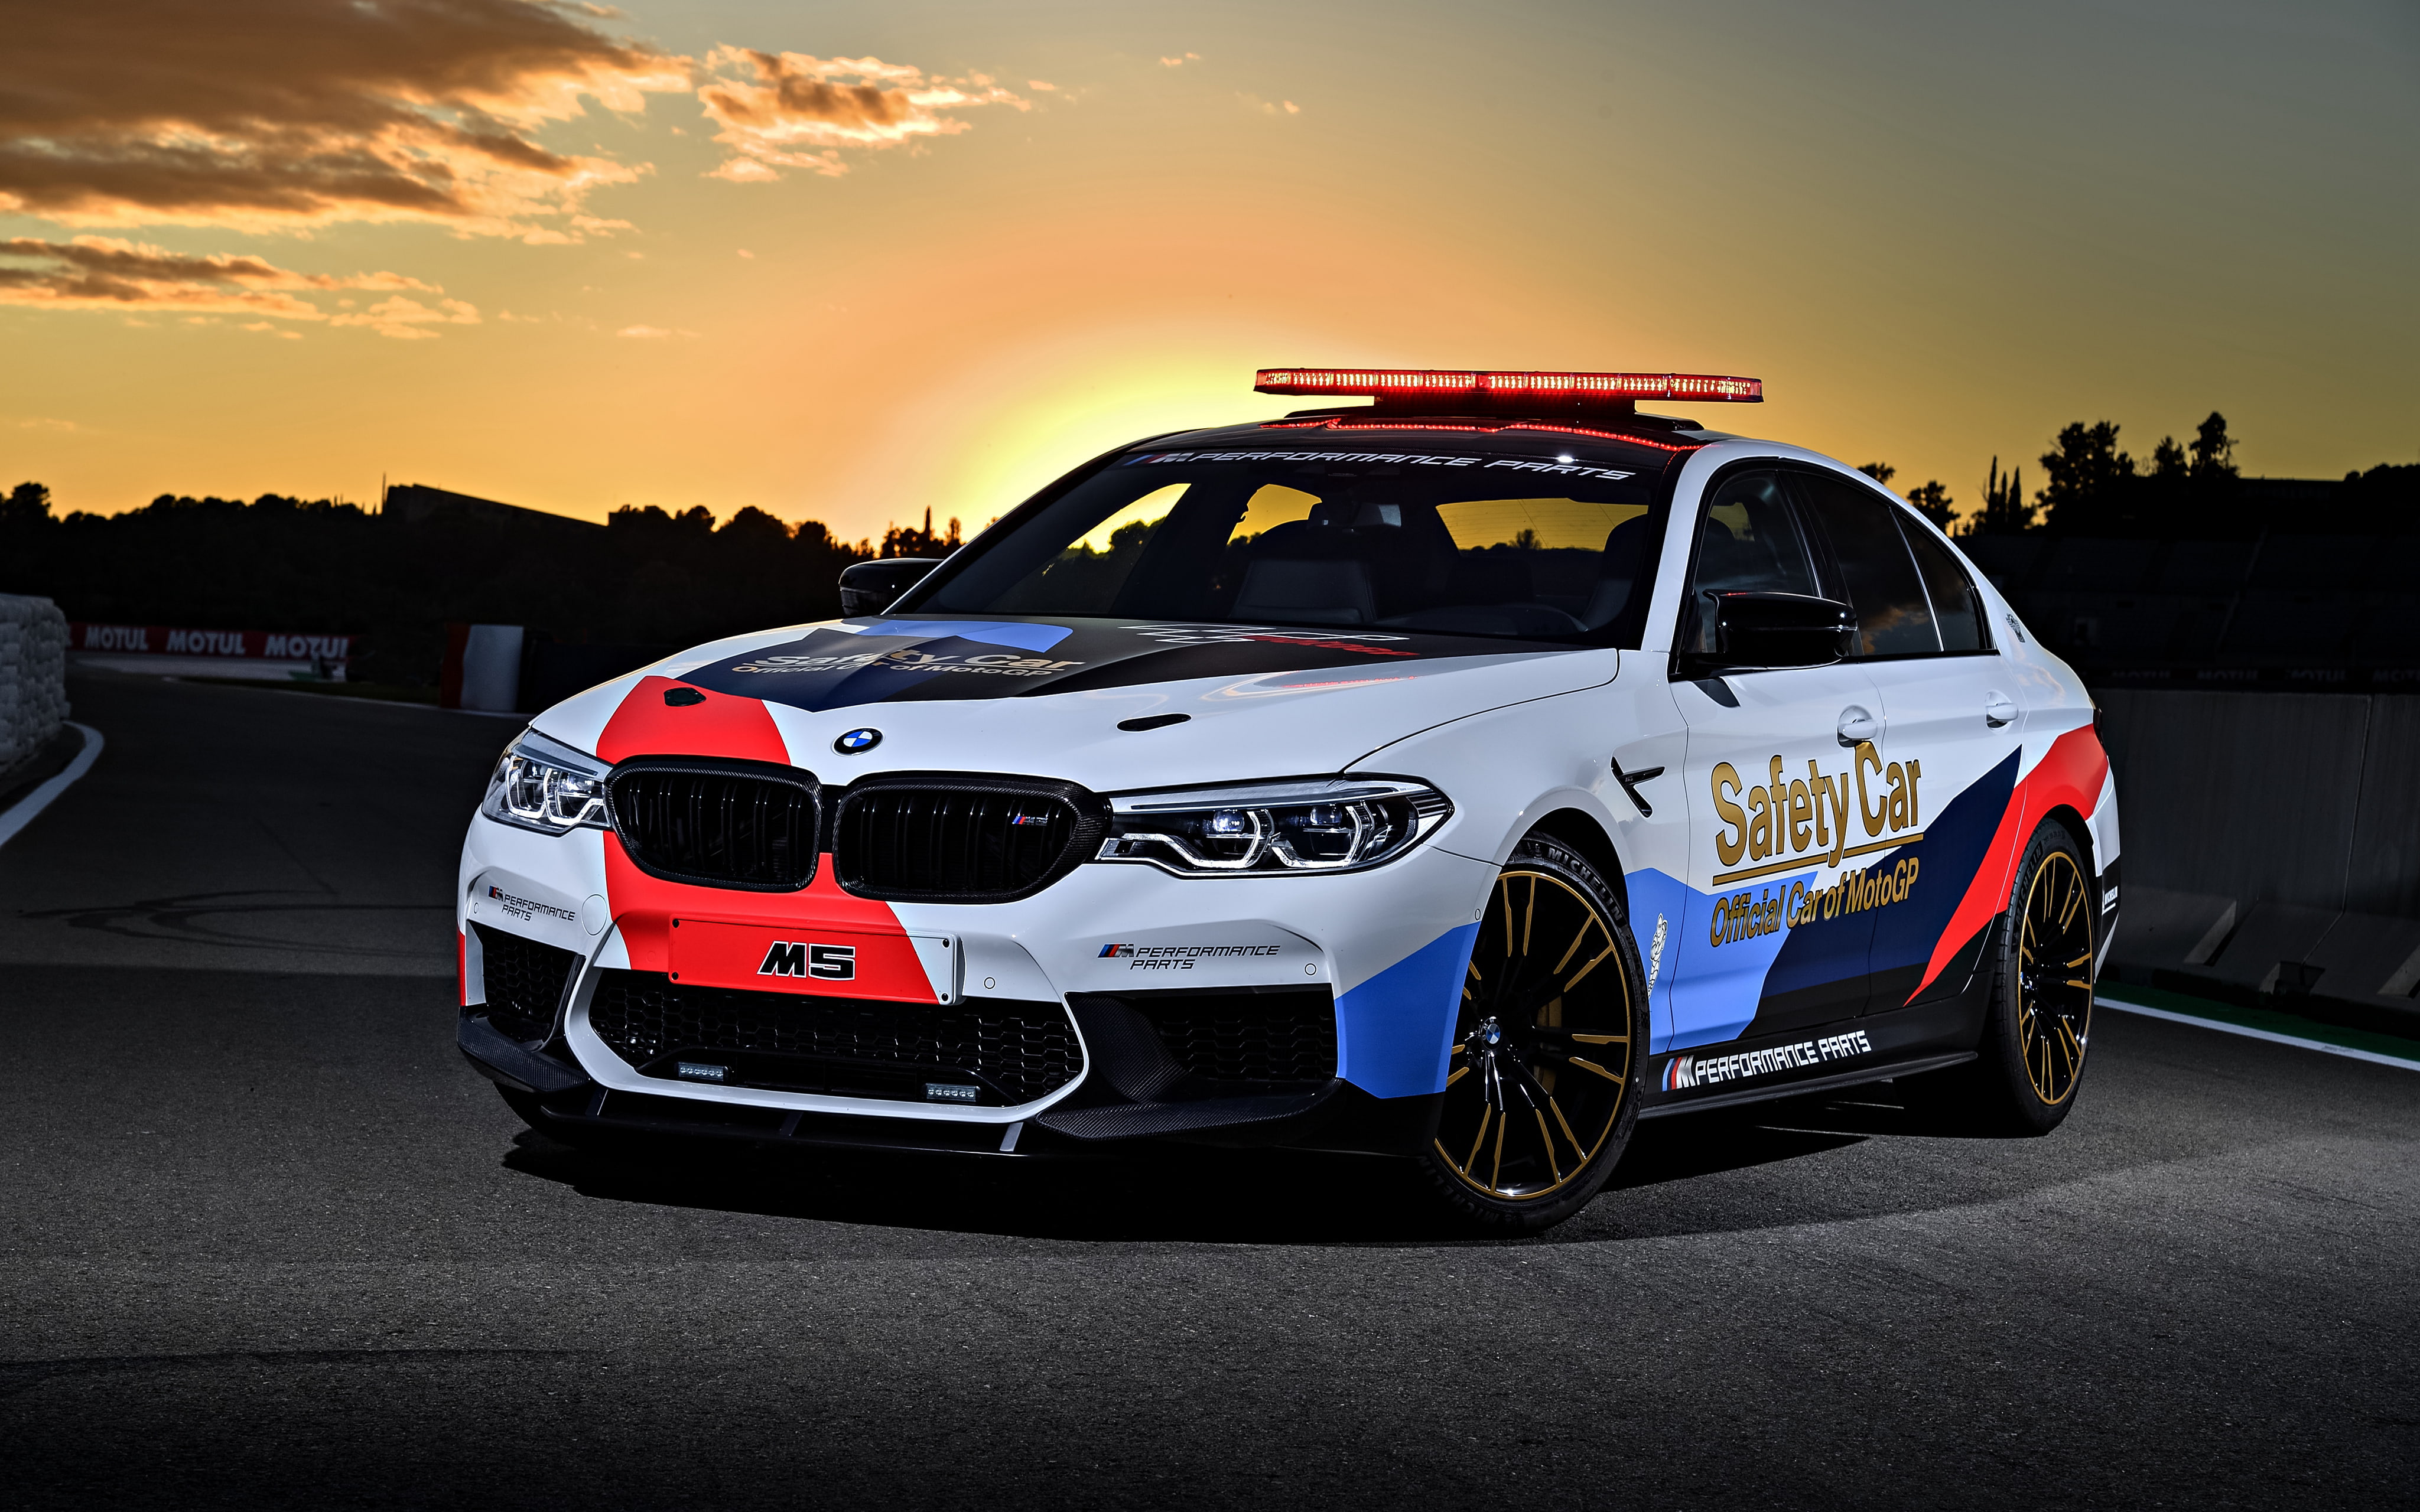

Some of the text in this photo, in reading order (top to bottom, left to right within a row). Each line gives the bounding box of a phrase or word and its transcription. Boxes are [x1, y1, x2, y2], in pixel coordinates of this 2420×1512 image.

[1188, 451, 1482, 467] PERFORMANCE
[1484, 460, 1636, 480] PARTS
[84, 625, 148, 650] MOTUL
[165, 628, 246, 656] MOTUL
[755, 650, 1086, 668] Safety Car
[923, 665, 1053, 677] MotoGP
[1711, 740, 1921, 868] Safety Car
[1547, 846, 1623, 921] MICHELIN
[2015, 843, 2042, 926] MICHELIN
[501, 904, 532, 921] PARTS
[503, 894, 576, 921] PERFORMANCE
[1710, 856, 1920, 947] Official Car of MotoGP
[757, 941, 856, 981] M5
[1130, 959, 1196, 970] PARTS
[1136, 946, 1281, 957] PERFORMANCE
[1696, 1041, 1819, 1086] PERFORMANCE
[1817, 1029, 1872, 1061] PARTS
